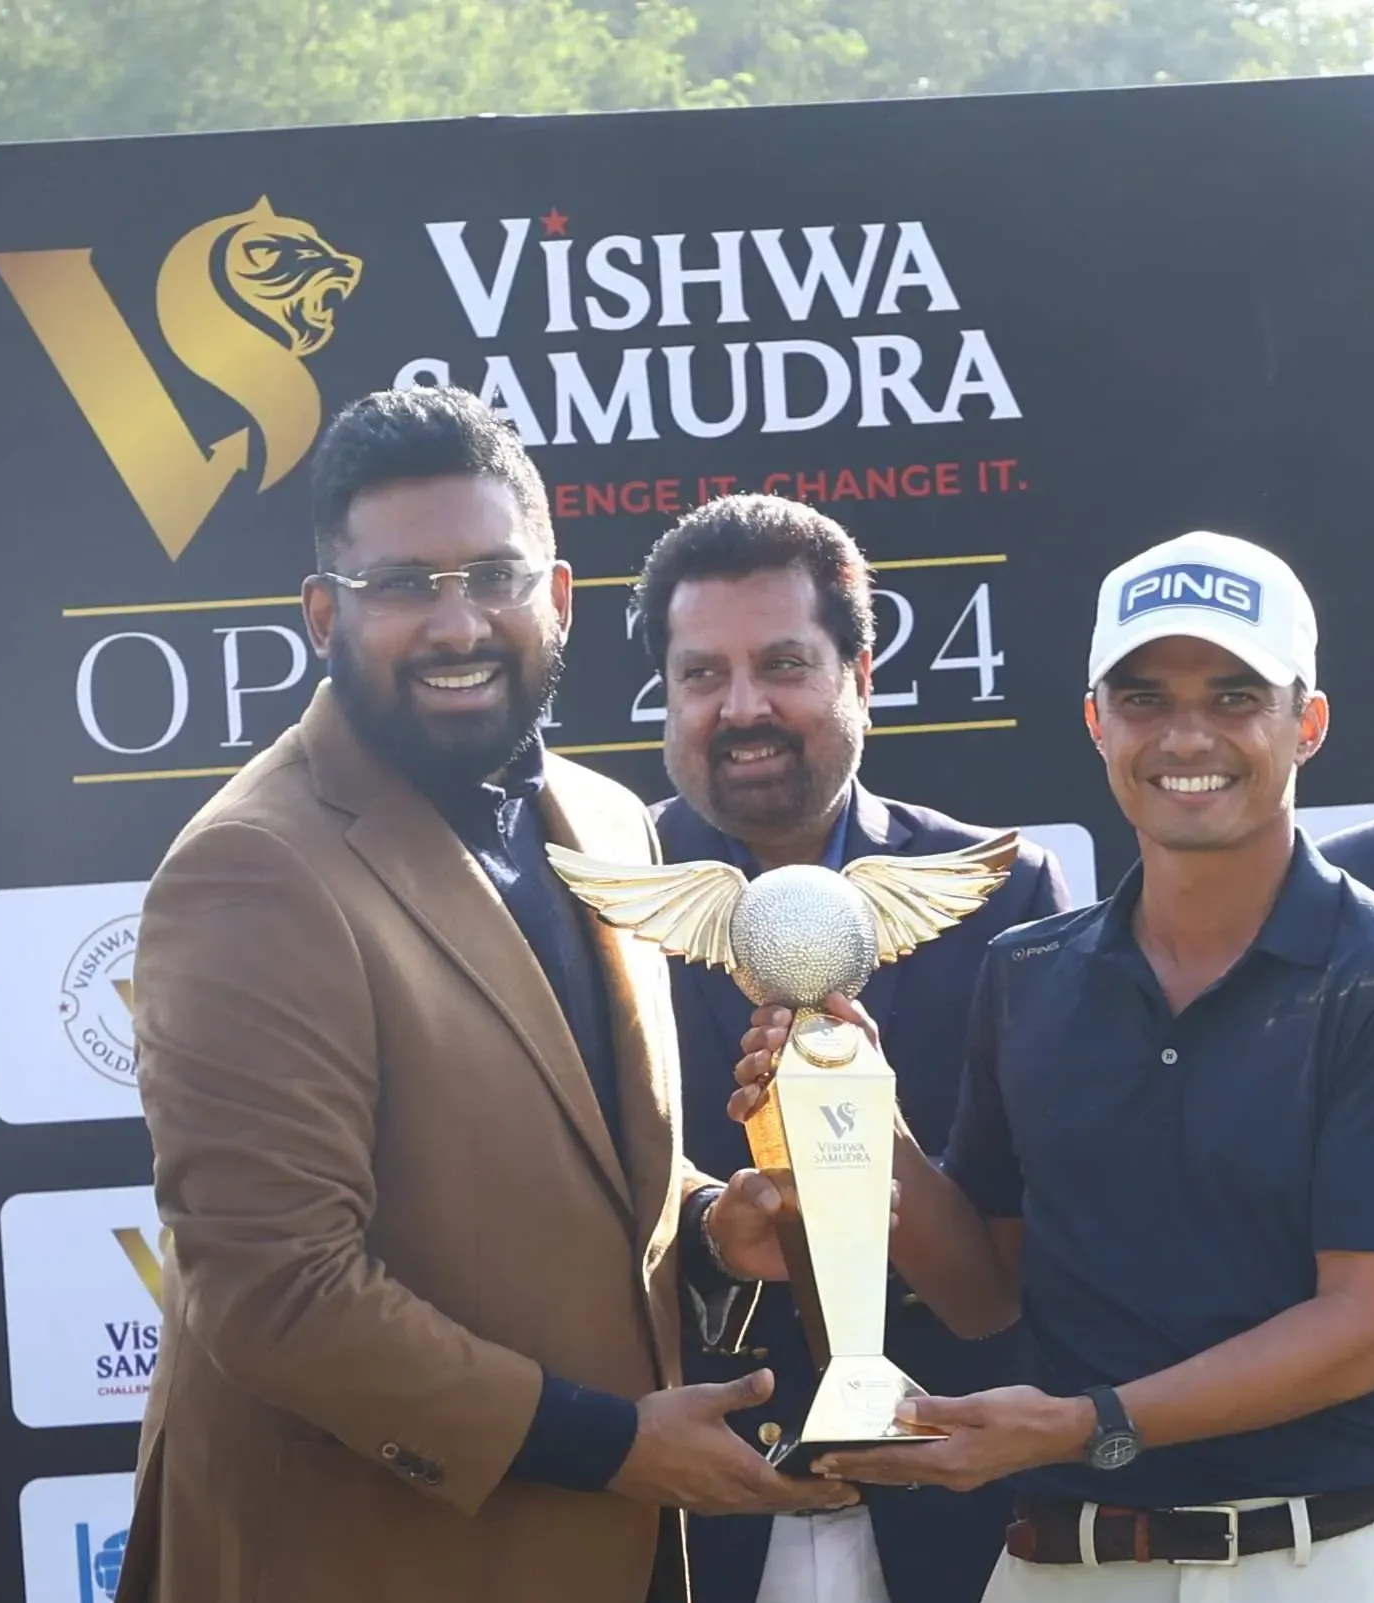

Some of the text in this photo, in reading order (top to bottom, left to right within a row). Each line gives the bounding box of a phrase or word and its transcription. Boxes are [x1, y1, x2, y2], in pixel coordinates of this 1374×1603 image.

[424, 207, 961, 338] VISHWA
[767, 461, 962, 502] CHANGE
[978, 459, 1028, 493] IT.
[1127, 571, 1251, 611] PING
[73, 928, 136, 990] VISHWA
